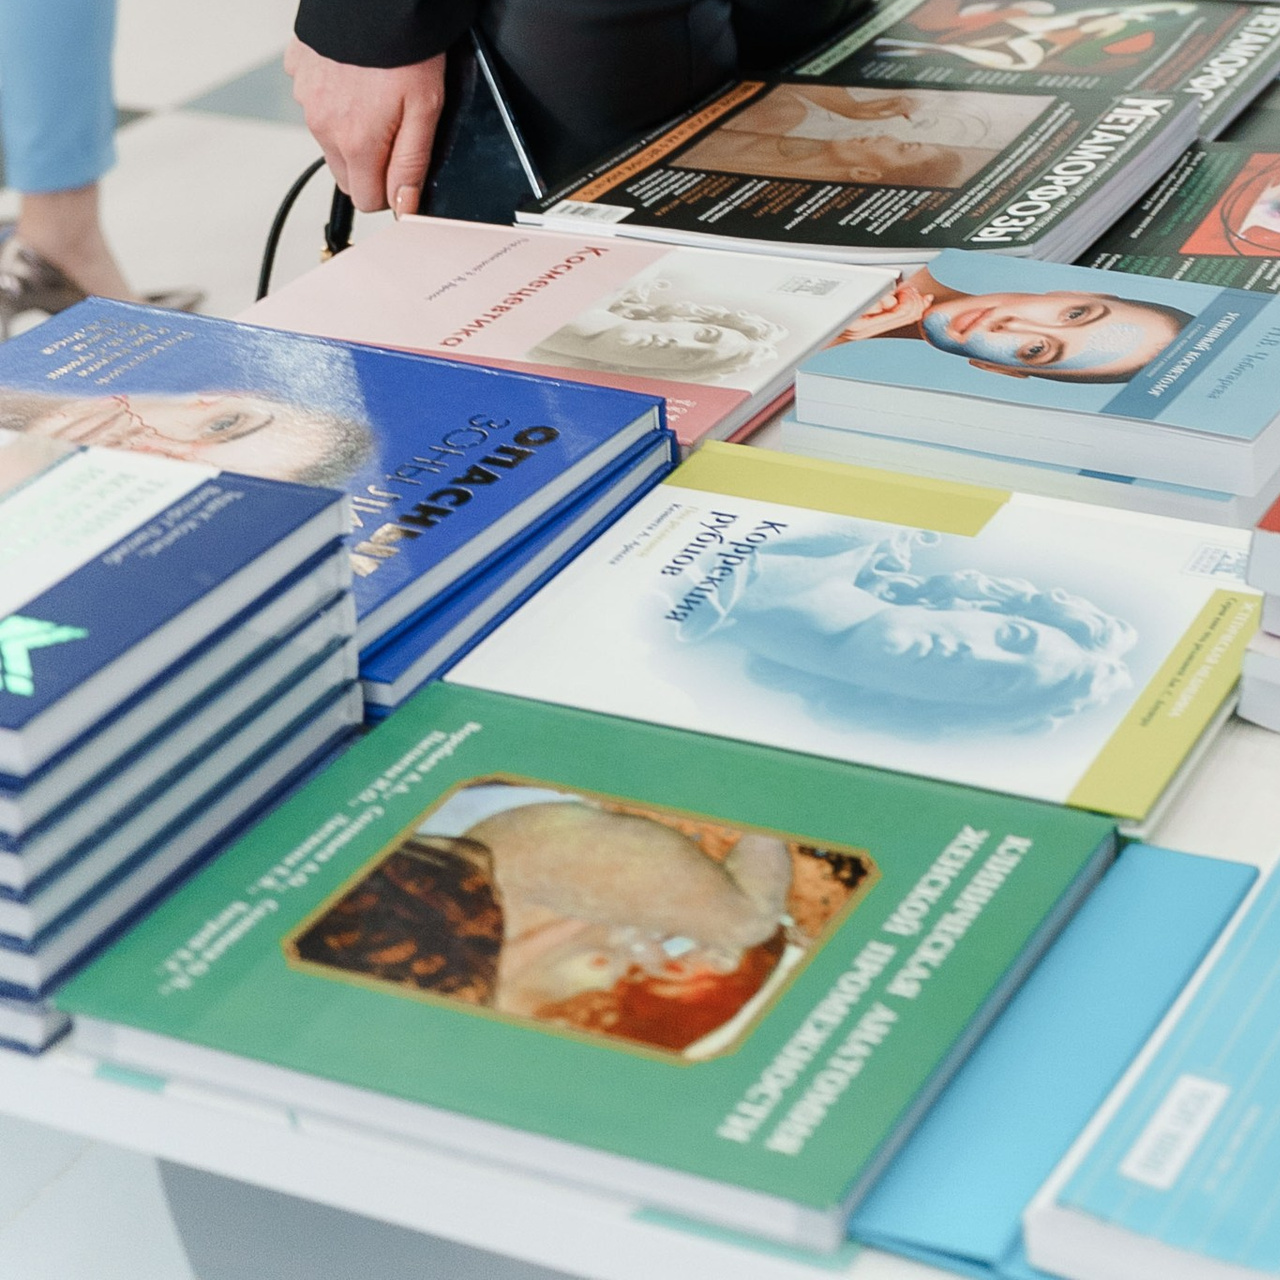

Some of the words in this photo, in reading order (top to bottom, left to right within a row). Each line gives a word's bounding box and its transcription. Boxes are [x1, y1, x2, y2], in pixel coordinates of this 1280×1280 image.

[971, 97, 1175, 242] МЕТАМОРФОЗЫ
[440, 246, 610, 348] Космецевтика
[385, 413, 511, 486] ЗОНЫ
[661, 510, 740, 576] рубцов
[663, 519, 790, 623] Коррекция
[881, 824, 990, 937] ЖЕНСКОЙ
[886, 834, 1033, 999] КЛИНИЧЕСКАЯ
[715, 939, 897, 1144] ПРОМЕЖНОСТИ
[765, 1001, 898, 1156] АНАТОМИЯ
